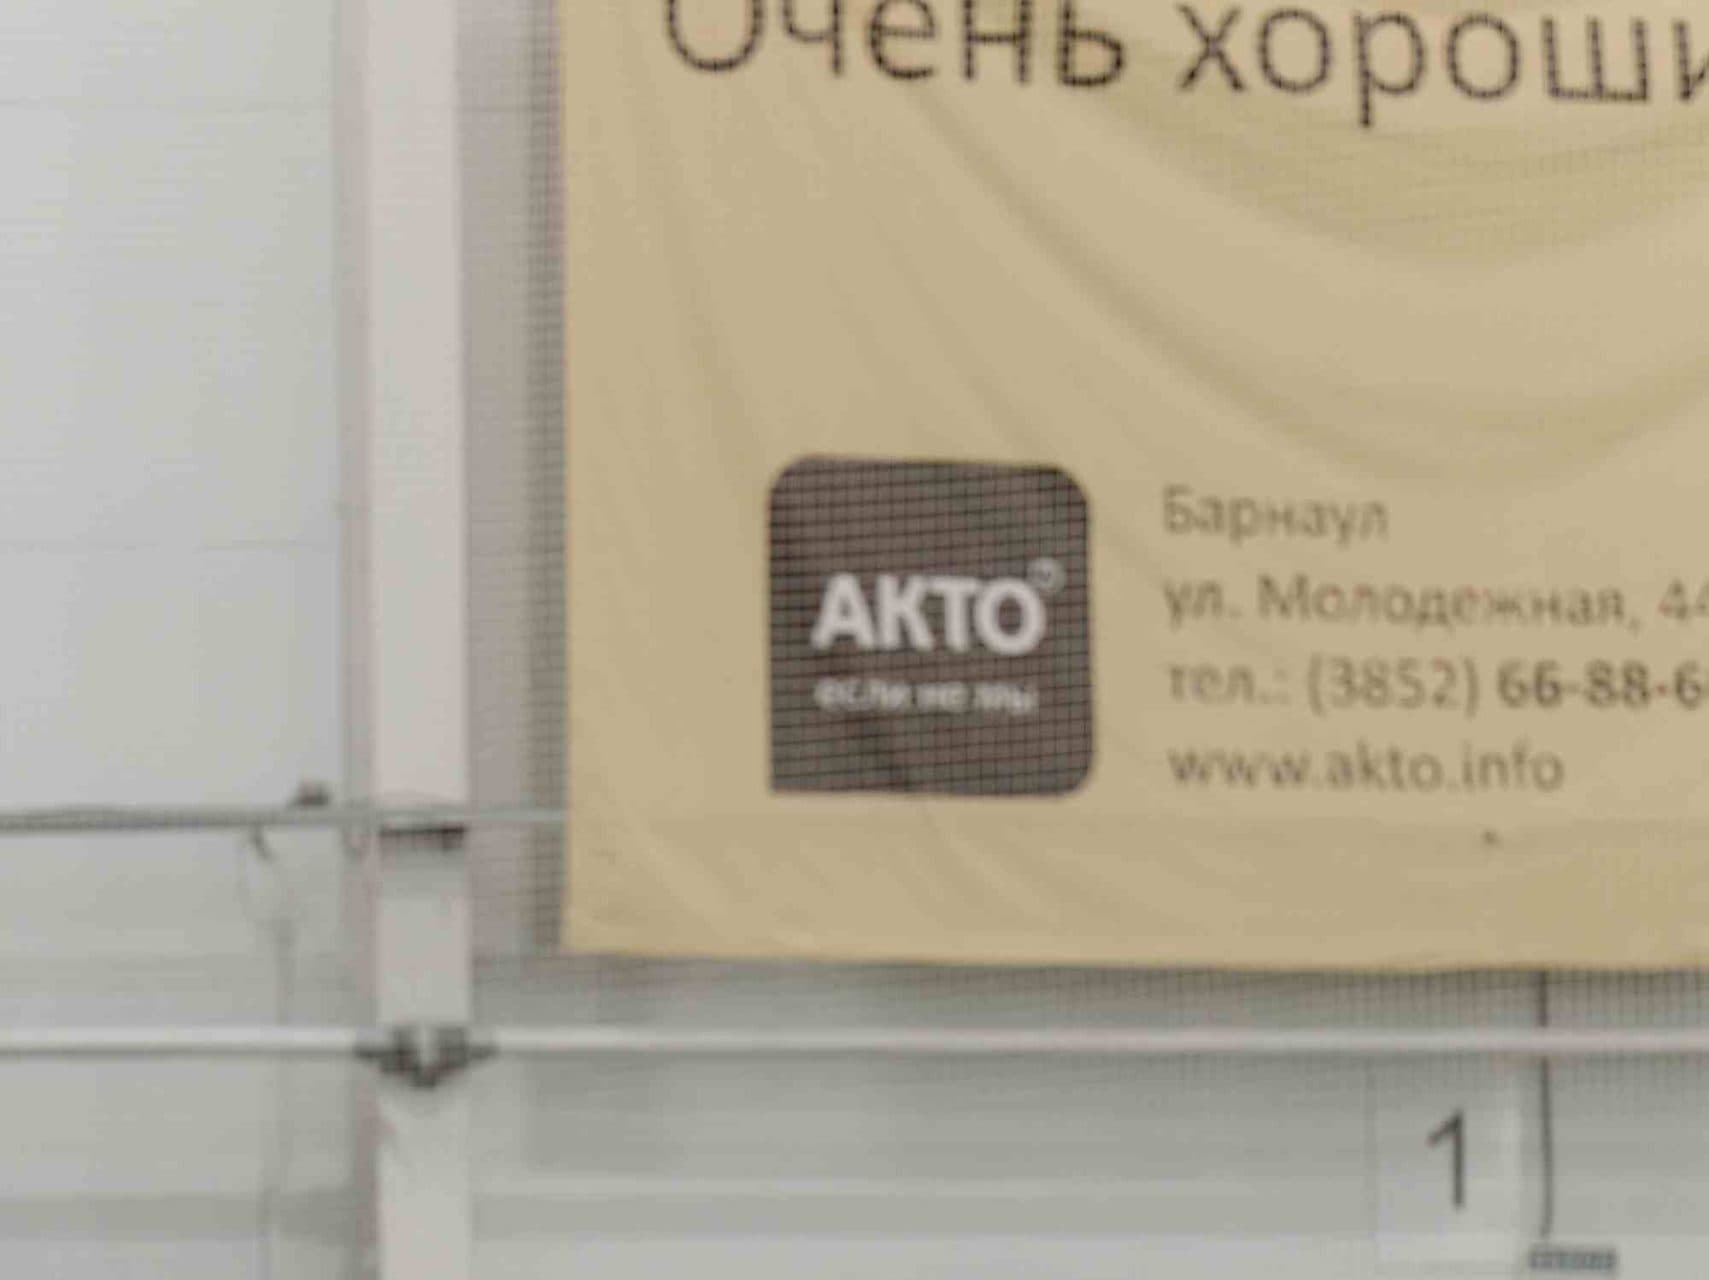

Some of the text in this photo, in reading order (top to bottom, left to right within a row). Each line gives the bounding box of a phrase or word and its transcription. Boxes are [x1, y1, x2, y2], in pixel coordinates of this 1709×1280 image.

[665, 0, 1127, 89] Очень
[1163, 485, 1389, 548] Барнаул
[810, 573, 1047, 654] АКТО
[1164, 579, 1242, 631] ул.
[1256, 575, 1638, 639] Молодежная,
[1307, 653, 1479, 719] (3852)
[1497, 659, 1709, 710] 66-88-6
[1168, 741, 1565, 792] www.akto.info
[1427, 1108, 1465, 1211] 1
